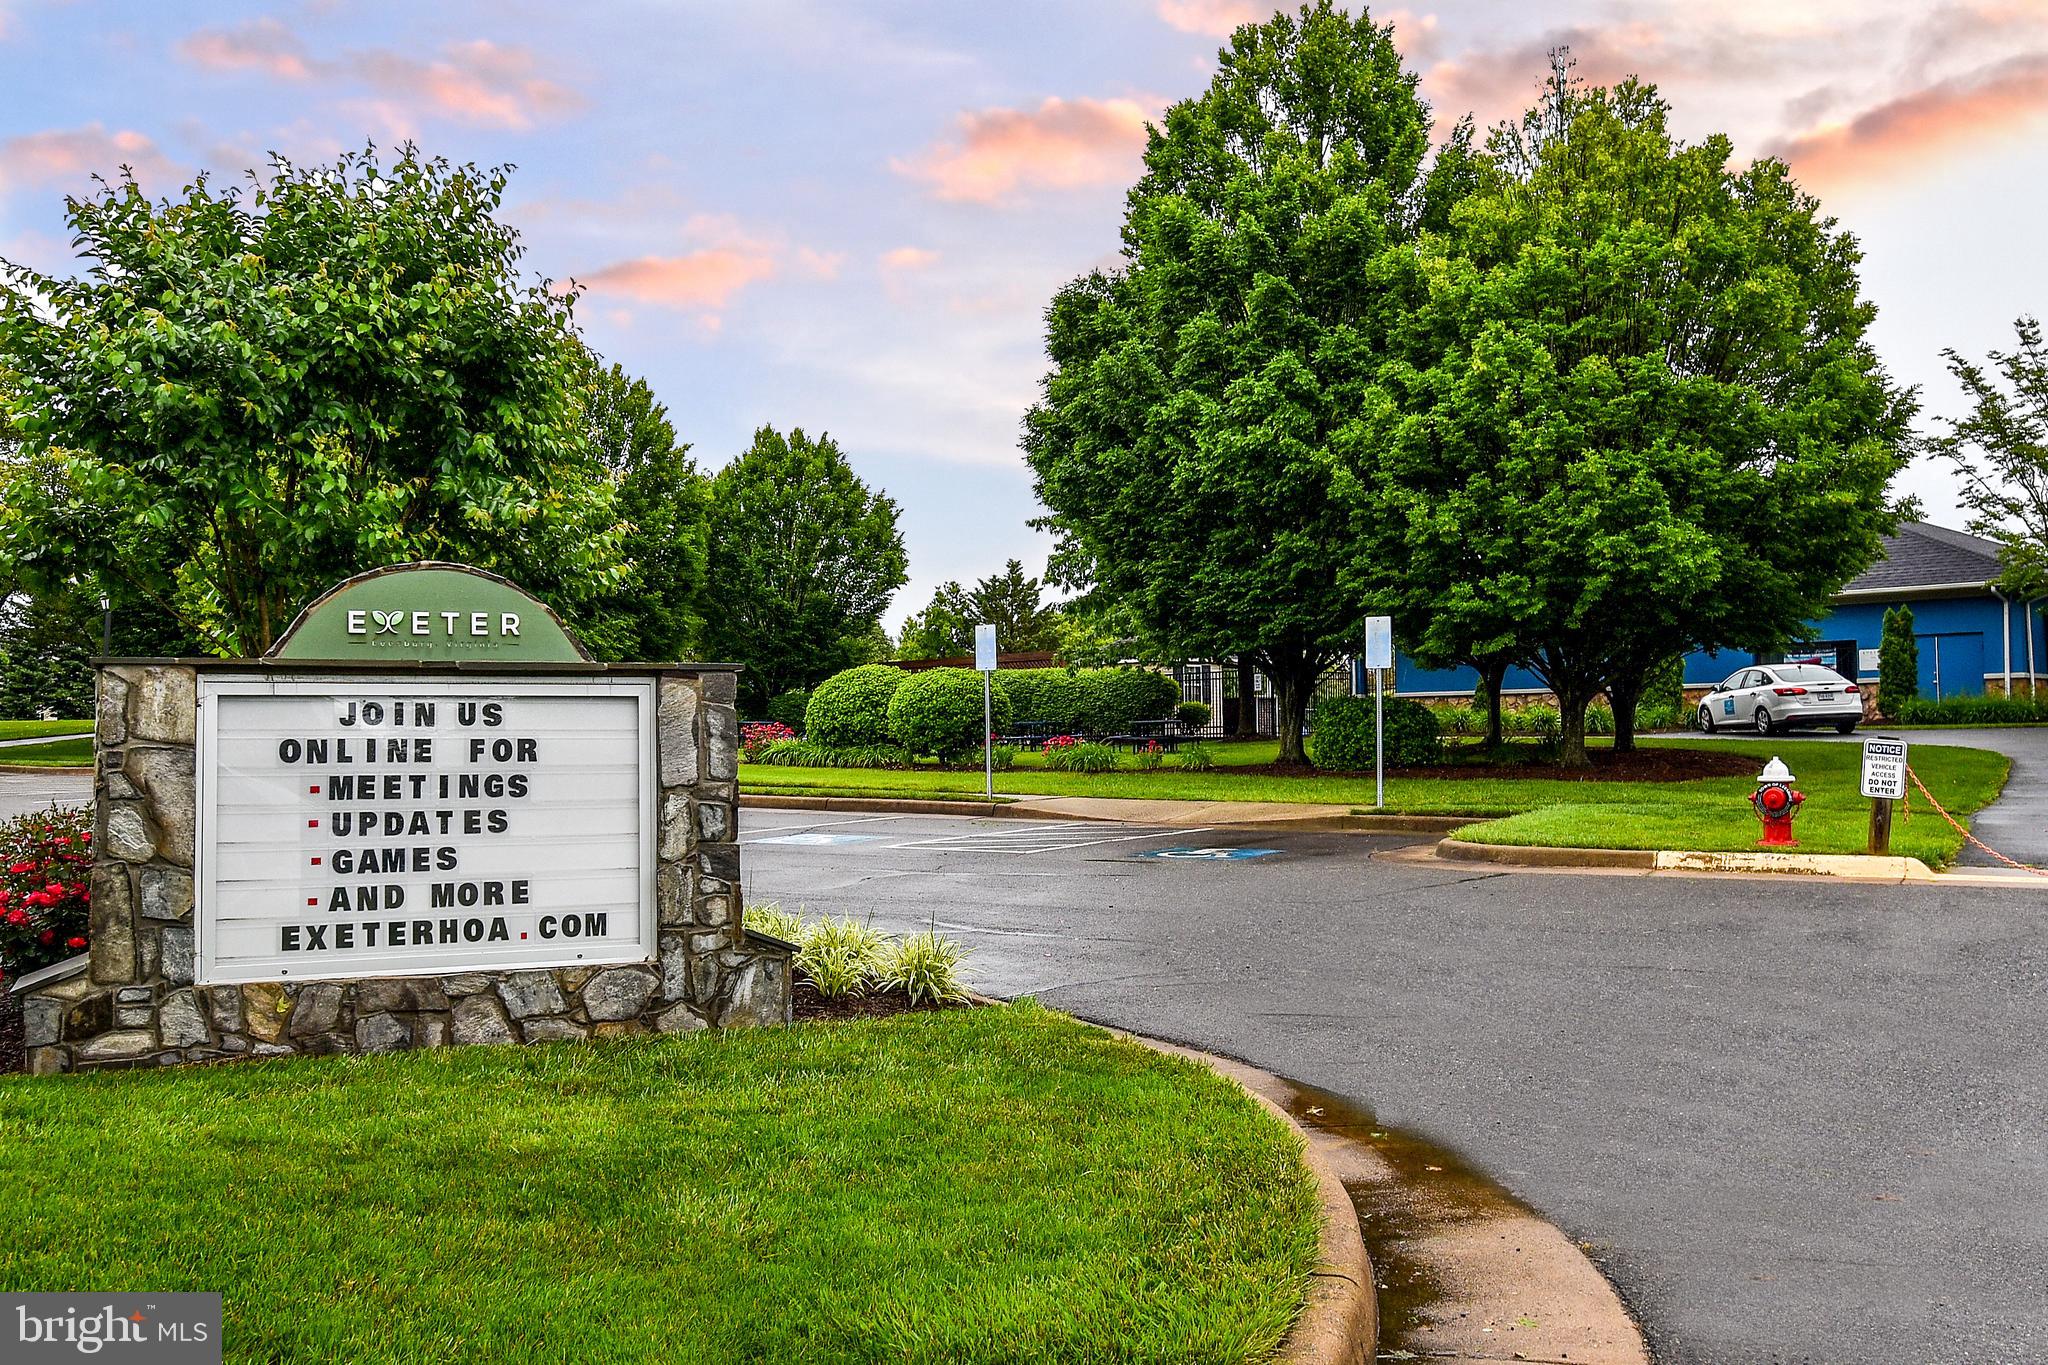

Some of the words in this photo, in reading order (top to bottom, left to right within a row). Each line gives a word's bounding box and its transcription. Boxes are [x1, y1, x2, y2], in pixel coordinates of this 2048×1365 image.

[347, 609, 520, 636] EXETER
[339, 702, 435, 727] JOIN
[458, 702, 503, 726] US
[279, 738, 432, 764] ONLINE
[470, 738, 538, 763] FOR
[1866, 755, 1903, 763] RESTRICTED
[1869, 744, 1902, 754] NOTICE
[1871, 763, 1897, 771] VEHICLE
[1871, 771, 1896, 779] ACCESS
[329, 774, 528, 801] MEETINGS
[1869, 786, 1895, 795] ENTER
[332, 810, 508, 836] UPDATES
[332, 847, 458, 874] GAMES
[329, 885, 405, 912] AND
[432, 880, 529, 908] MORE
